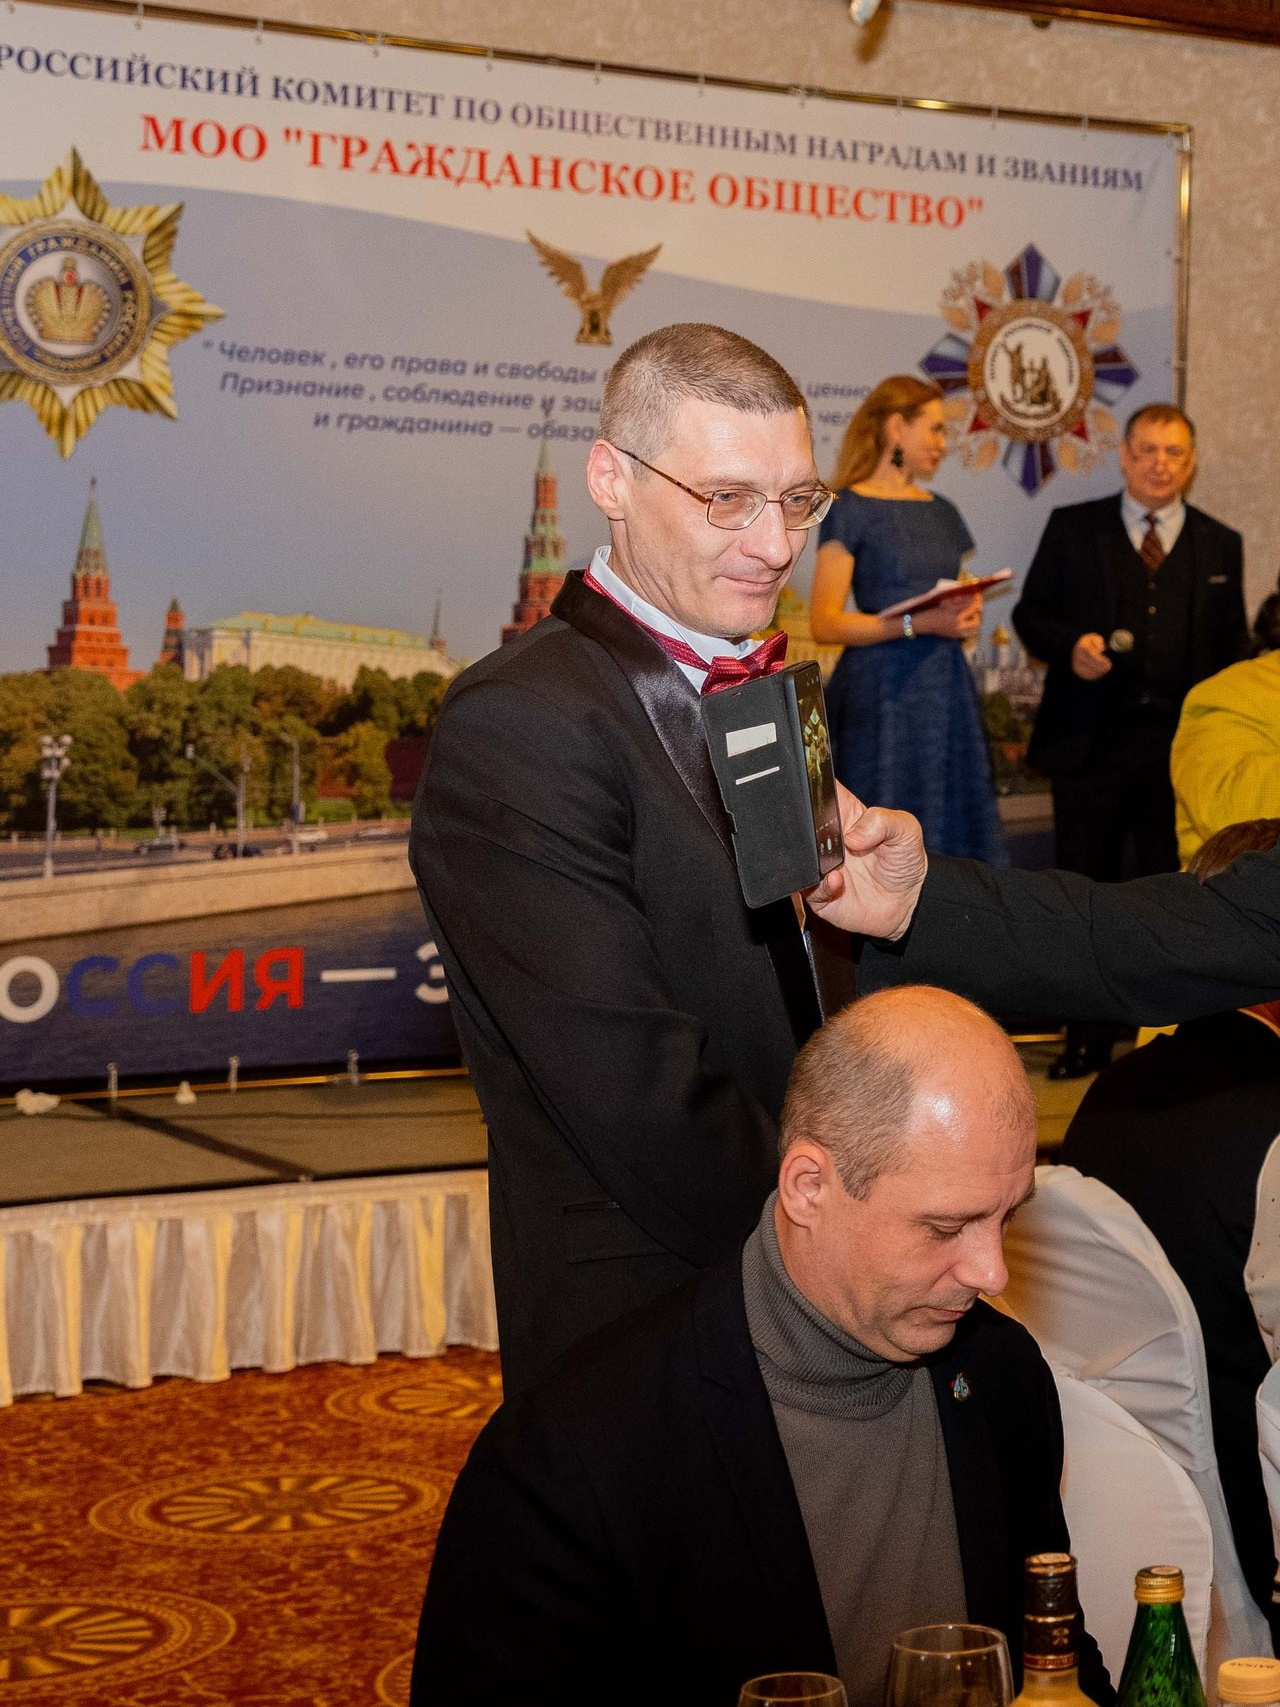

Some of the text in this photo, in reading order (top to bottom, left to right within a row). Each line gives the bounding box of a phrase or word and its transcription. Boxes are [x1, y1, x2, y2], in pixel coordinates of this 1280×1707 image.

[271, 75, 446, 119] КОМИТЕТ
[453, 95, 501, 125] ПО
[510, 101, 798, 157] ОБЩЕСТВЕННЫМ
[807, 134, 967, 175] НАГРАДАМ
[975, 152, 996, 177] И
[1002, 156, 1144, 192] ЗВАНИЯМ
[139, 113, 984, 231] МОО "ГРАЖДАНСКОЕ ОБЩЕСТВО"
[344, 353, 385, 371] его
[391, 355, 467, 377] права
[473, 361, 489, 377] и
[495, 360, 597, 384] свободы
[382, 382, 534, 410] соблюдение
[313, 413, 330, 429] и
[336, 413, 494, 438] гражданина
